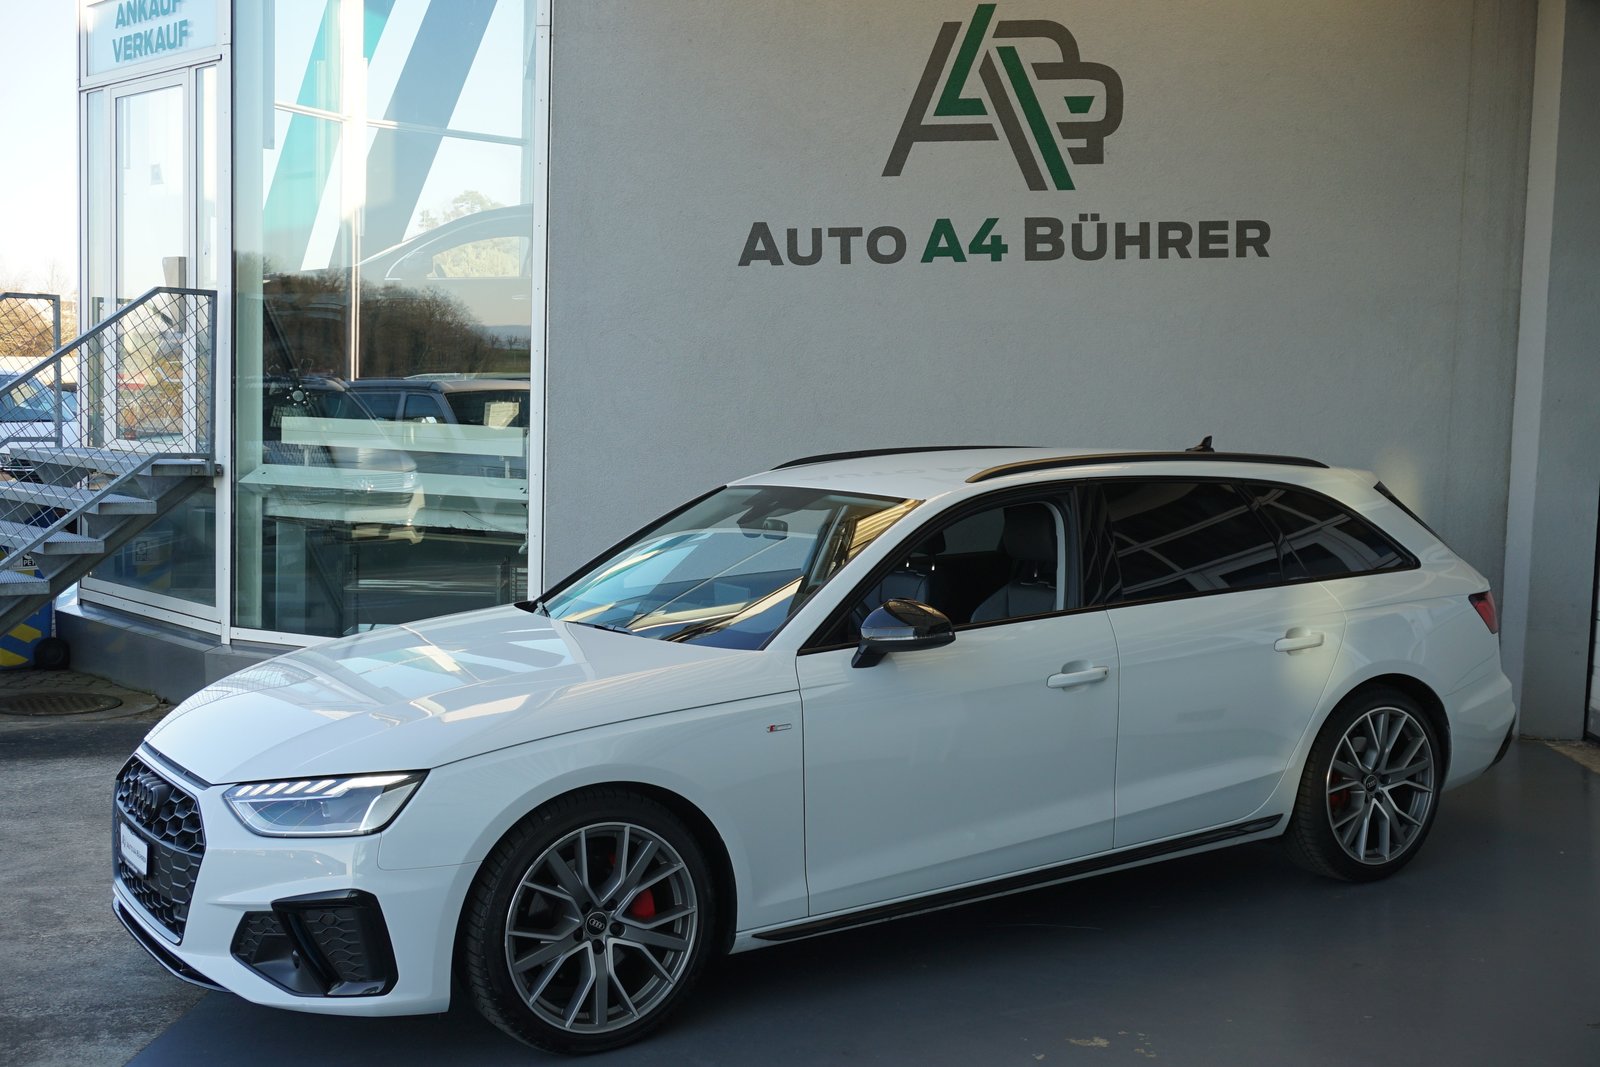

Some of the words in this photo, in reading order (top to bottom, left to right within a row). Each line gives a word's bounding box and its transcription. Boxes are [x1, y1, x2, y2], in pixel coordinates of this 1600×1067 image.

[112, 19, 188, 62] VERKAUF
[920, 217, 1008, 263] A4
[1024, 213, 1271, 261] BÜHRER
